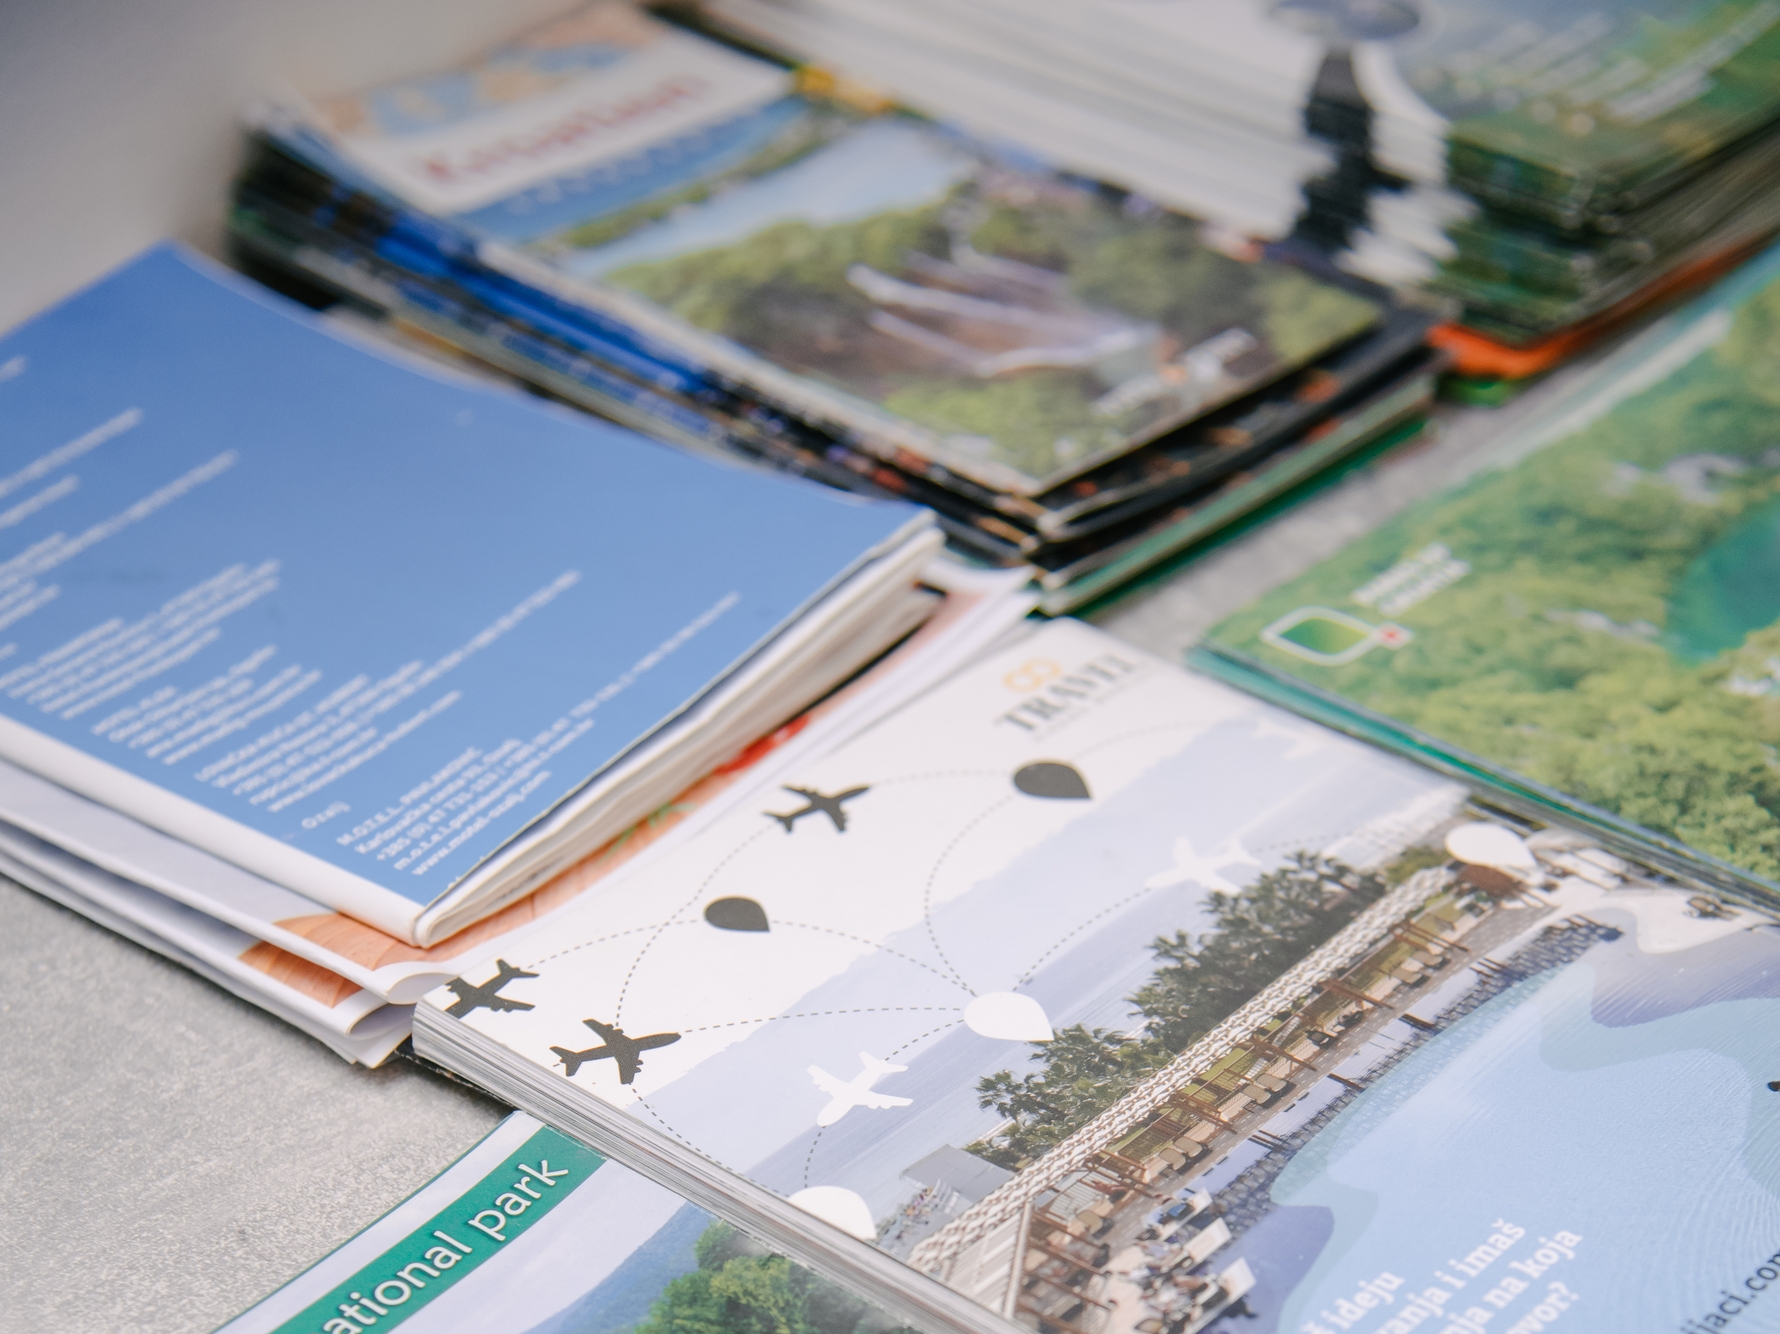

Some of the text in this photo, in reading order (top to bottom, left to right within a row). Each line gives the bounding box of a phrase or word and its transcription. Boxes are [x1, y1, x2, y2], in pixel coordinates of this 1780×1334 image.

[467, 1158, 569, 1242] park
[1453, 1216, 1527, 1279] imaš
[1482, 1274, 1526, 1310] na
[1511, 1227, 1583, 1282] koja
[1322, 1270, 1405, 1333] ideju
[1446, 1270, 1468, 1291] i
